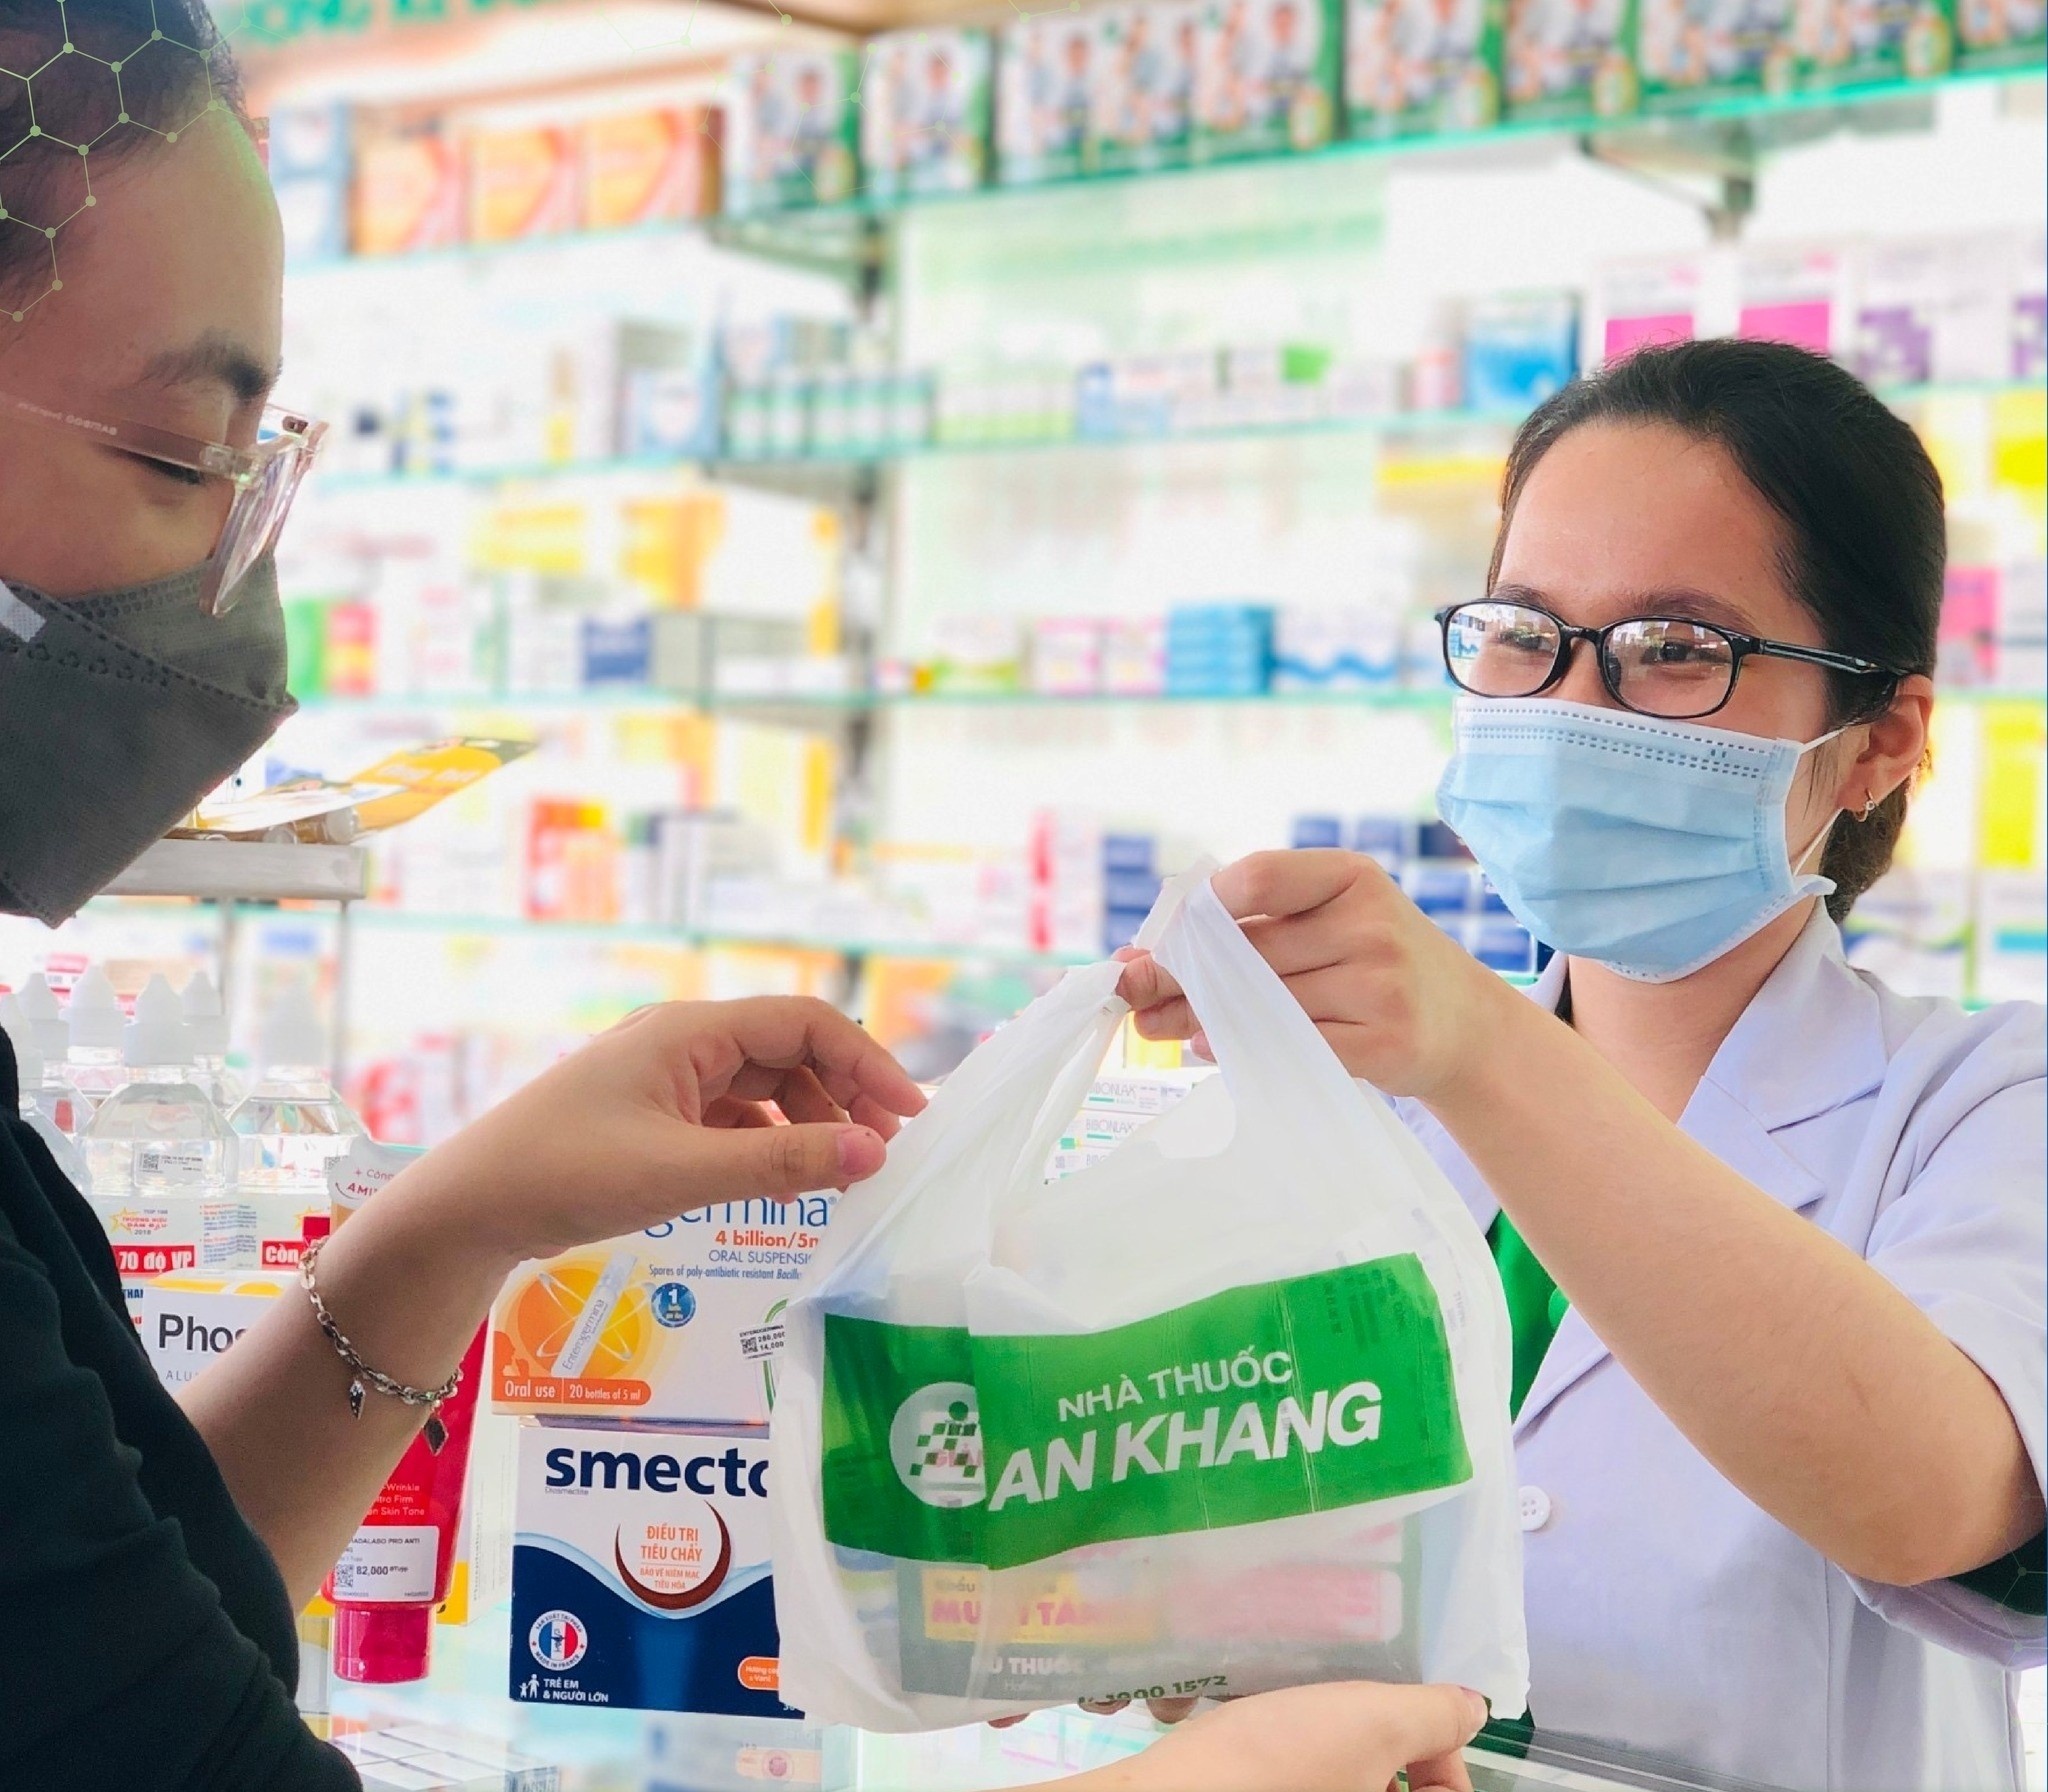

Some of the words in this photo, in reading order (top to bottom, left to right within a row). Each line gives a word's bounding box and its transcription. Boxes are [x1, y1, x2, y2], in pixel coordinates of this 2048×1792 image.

[347, 1182, 378, 1197] AMI
[715, 1230, 727, 1246] 4
[119, 1251, 139, 1270] 70
[143, 1251, 167, 1273] độ
[171, 1251, 193, 1269] VP
[708, 1249, 743, 1263] ORAL
[748, 1250, 811, 1265] SUSPENSI
[649, 1265, 674, 1277] Spores
[676, 1266, 685, 1276] of
[742, 1268, 774, 1279] resistant
[668, 1288, 678, 1304] 1
[165, 1369, 199, 1382] ALU
[1058, 1374, 1143, 1422] NHÀ
[1147, 1345, 1292, 1400] THUỐC
[505, 1380, 530, 1398] Oral
[535, 1384, 555, 1399] use
[569, 1384, 583, 1399] 20
[585, 1389, 610, 1400] bottles
[612, 1390, 621, 1400] of
[622, 1390, 628, 1400] 5
[630, 1390, 641, 1400] ml
[988, 1430, 1097, 1511] AN
[1112, 1381, 1382, 1483] KHANG
[381, 1506, 401, 1516] Skin
[646, 1522, 676, 1540] ĐIỀU
[679, 1527, 698, 1544] TRỊ
[641, 1543, 667, 1560] TIÊU
[671, 1544, 703, 1562] CHẢY
[356, 1566, 388, 1577] 82,000
[535, 1651, 550, 1667] MADE
[543, 1676, 561, 1688] TRẺ
[564, 1680, 579, 1689] EM
[1172, 1675, 1228, 1694] 1572
[543, 1690, 551, 1699] &
[553, 1690, 586, 1701] NGƯỜI
[588, 1691, 609, 1703] LỚN
